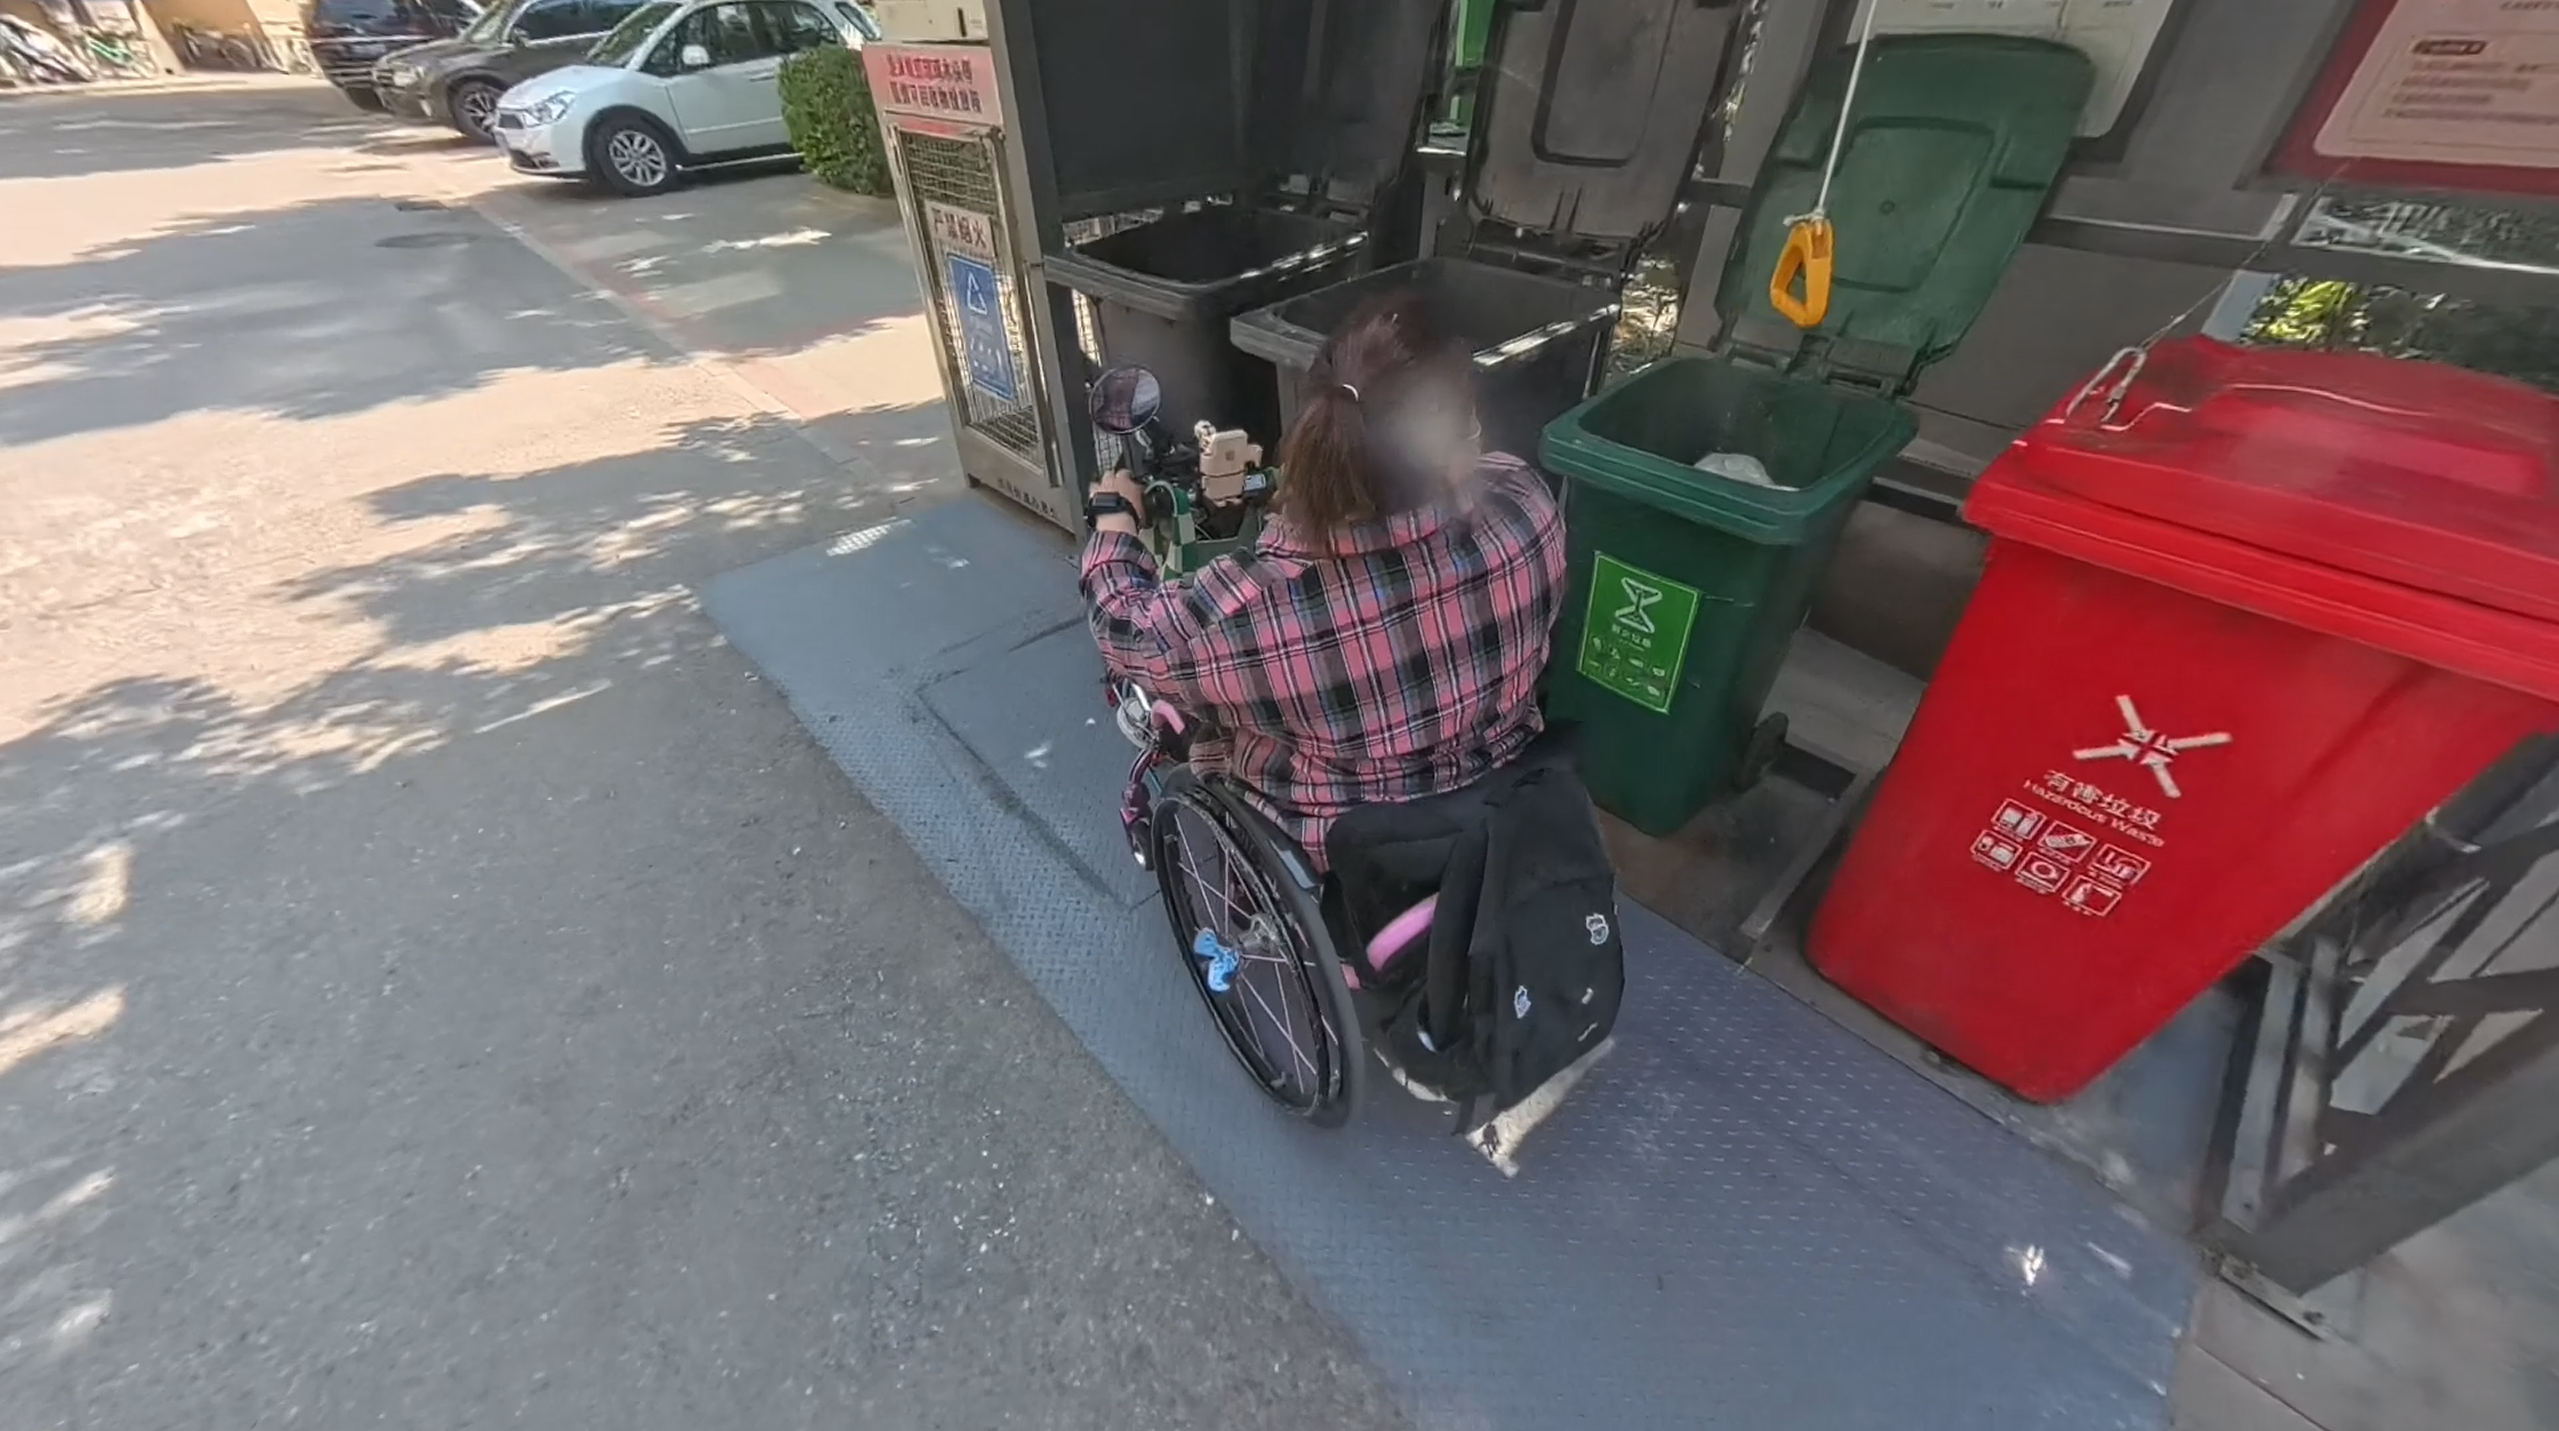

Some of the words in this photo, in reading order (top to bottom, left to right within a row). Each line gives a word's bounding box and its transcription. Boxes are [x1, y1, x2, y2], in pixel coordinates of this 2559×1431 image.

[2043, 769, 2162, 831] 有害垃圾
[2110, 817, 2166, 848] Waste
